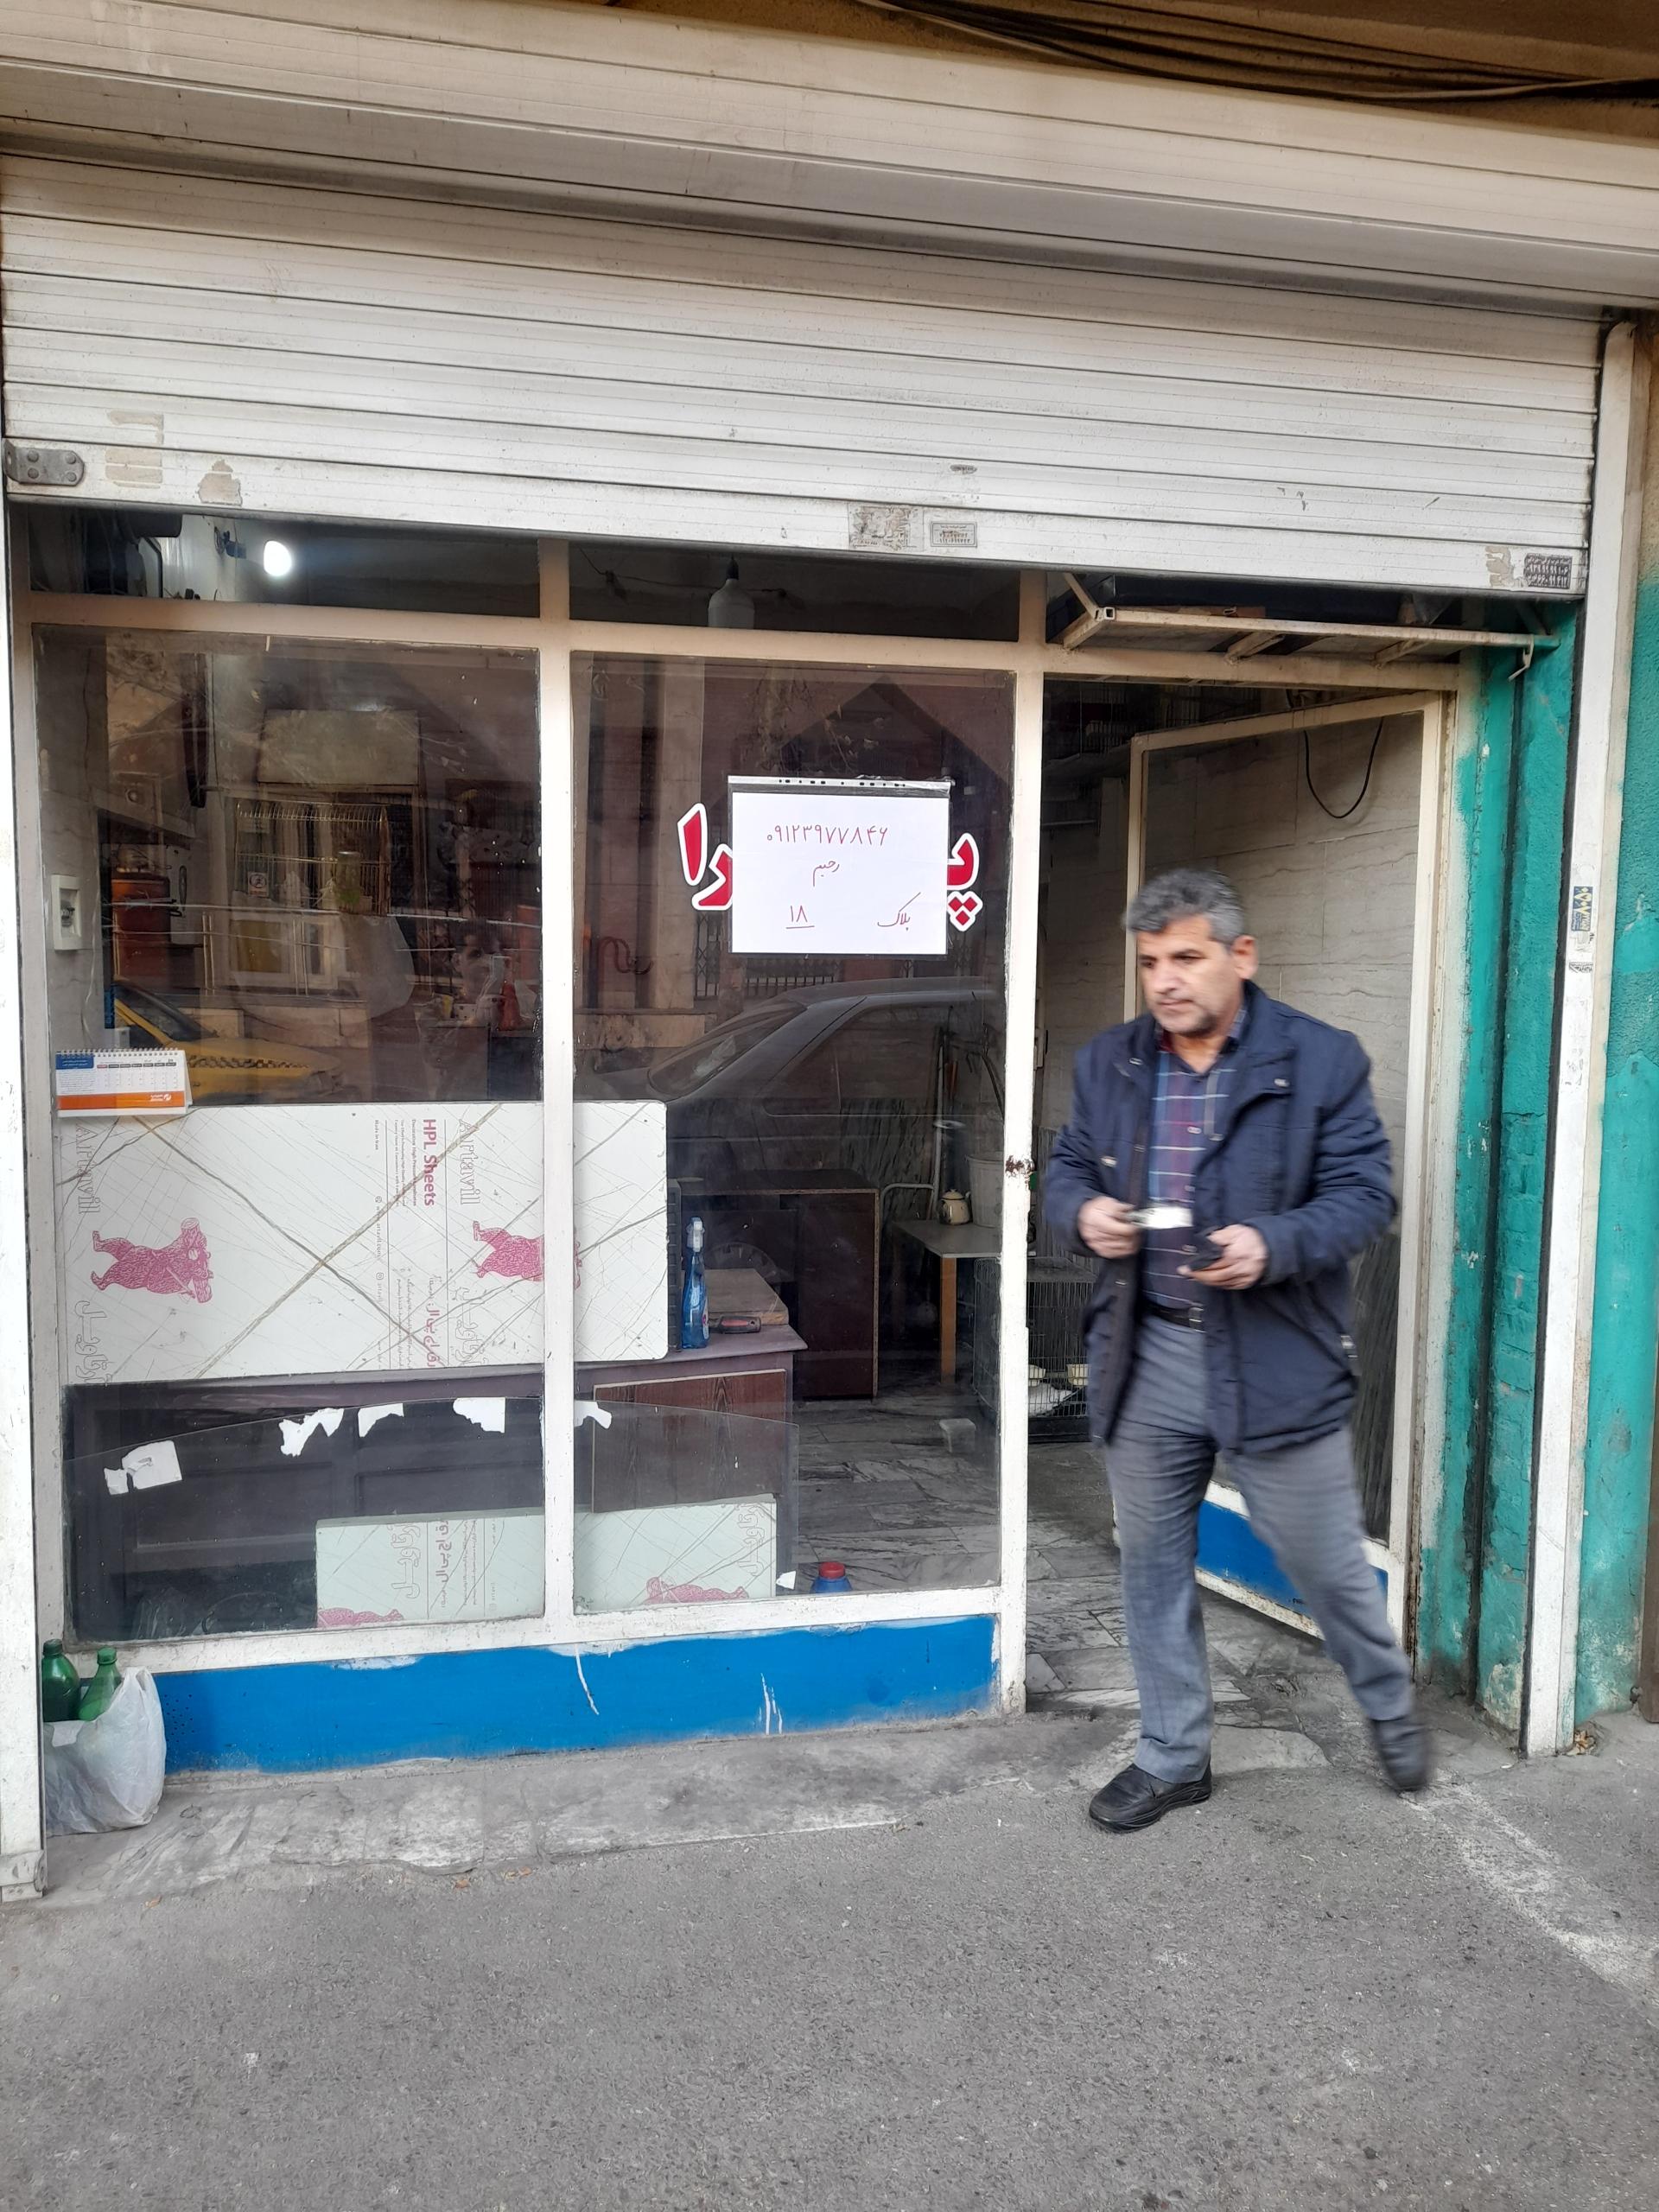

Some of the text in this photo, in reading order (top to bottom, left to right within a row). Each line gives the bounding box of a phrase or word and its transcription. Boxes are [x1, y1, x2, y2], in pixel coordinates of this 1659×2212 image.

[767, 824, 888, 846] ۰۹۱۲۳۹۷۷۸۴۶
[790, 892, 921, 931] پلاک ۱۸
[75, 1123, 102, 1216] Artavil
[423, 1118, 438, 1207] HPL Sheets
[459, 1119, 482, 1206] Artavil
